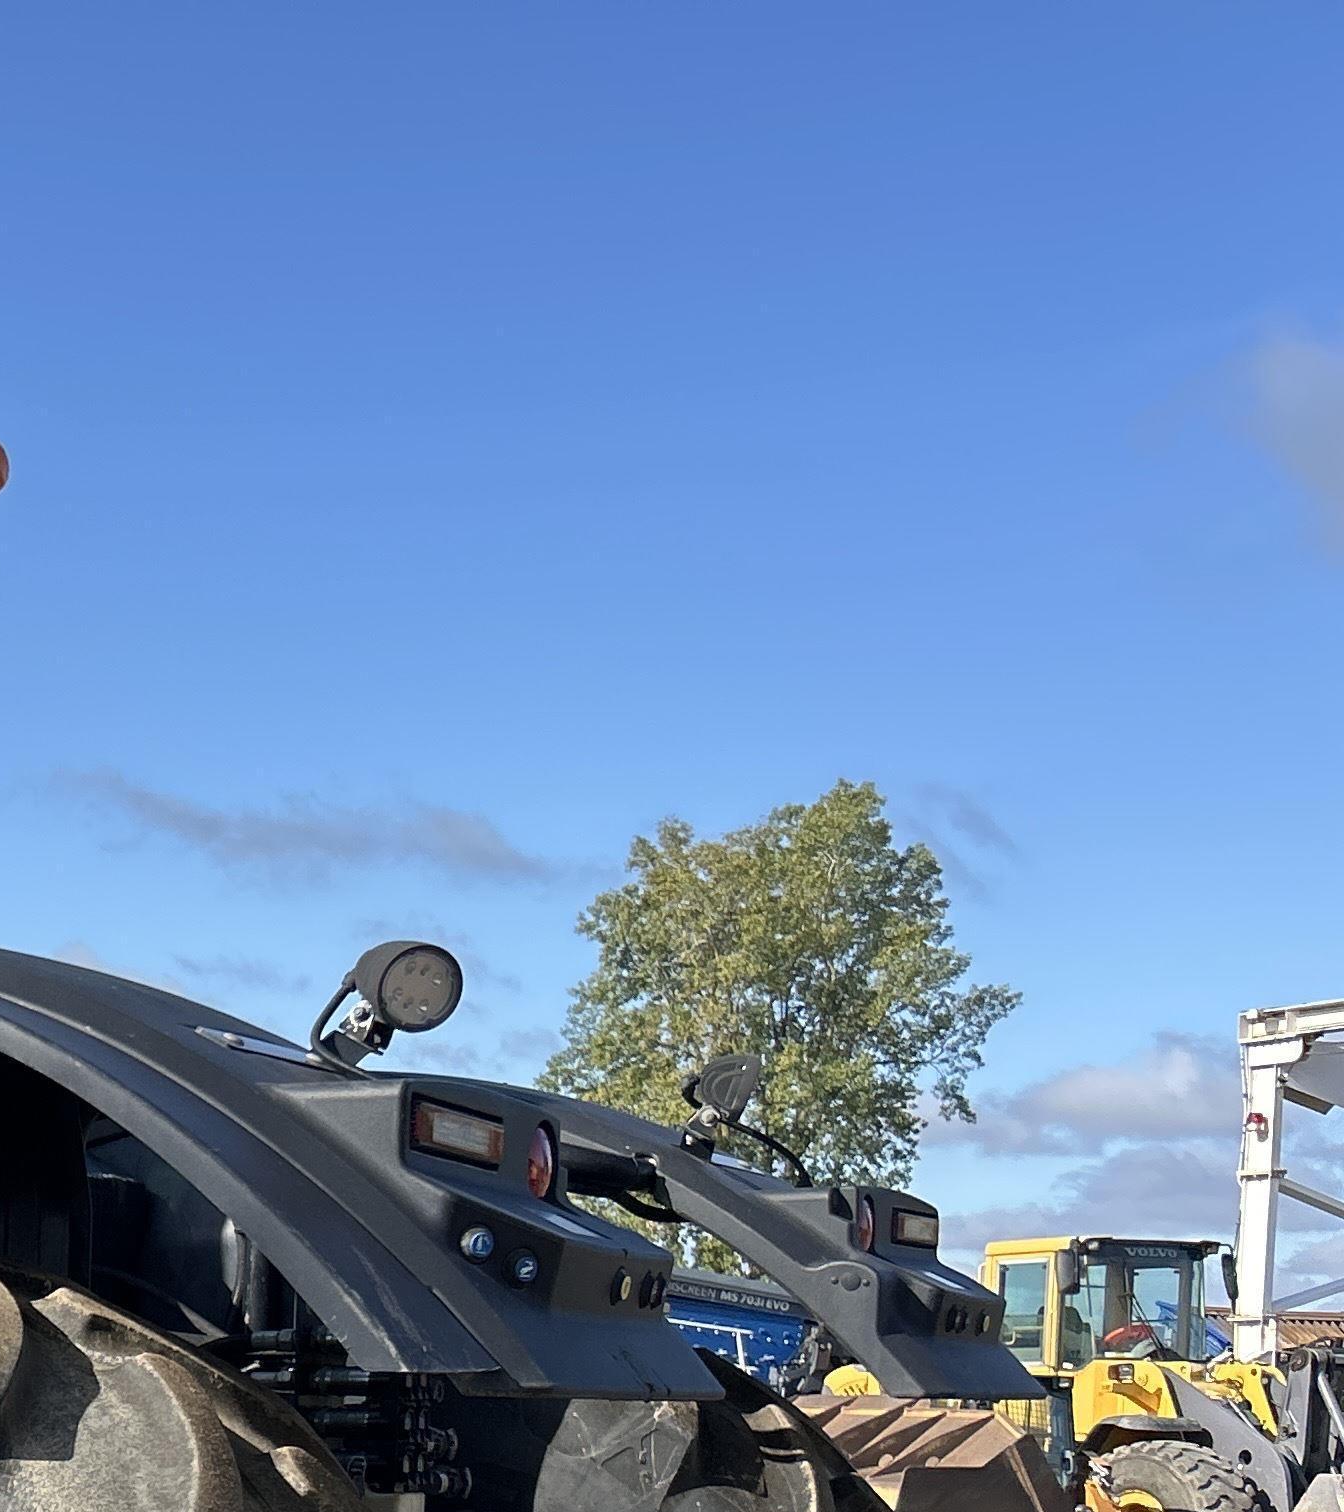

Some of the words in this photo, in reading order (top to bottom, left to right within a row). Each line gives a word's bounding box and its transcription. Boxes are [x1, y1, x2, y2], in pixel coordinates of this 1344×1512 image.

[1125, 1246, 1177, 1258] VOLVO
[720, 1289, 738, 1303] MS
[766, 1299, 790, 1312] EVO
